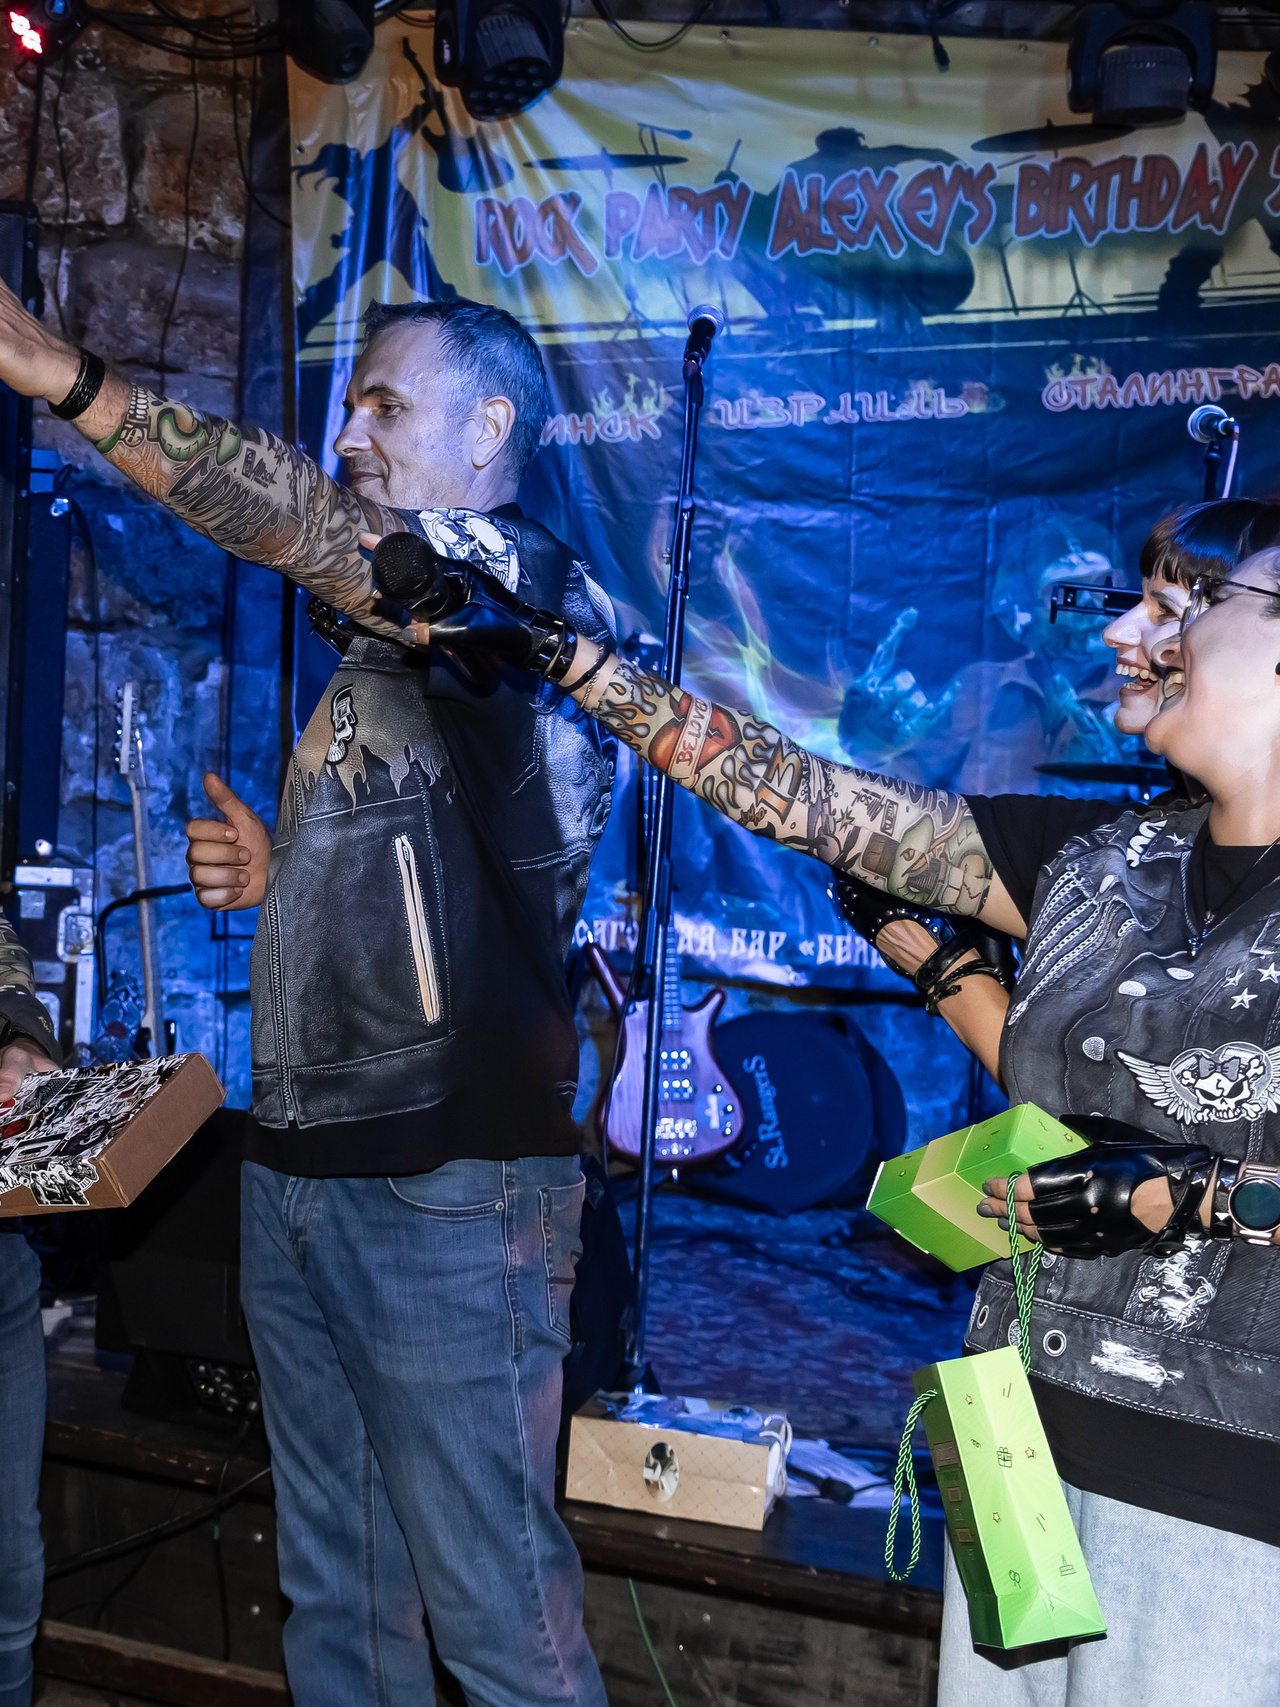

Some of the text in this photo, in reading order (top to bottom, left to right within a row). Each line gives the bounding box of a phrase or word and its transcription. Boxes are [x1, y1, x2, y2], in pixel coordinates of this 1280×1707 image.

[473, 191, 600, 277] ROCK
[604, 182, 751, 264] PARTY
[767, 162, 998, 259] ALEXEY'S
[1014, 141, 1258, 248] BIRTHDAY
